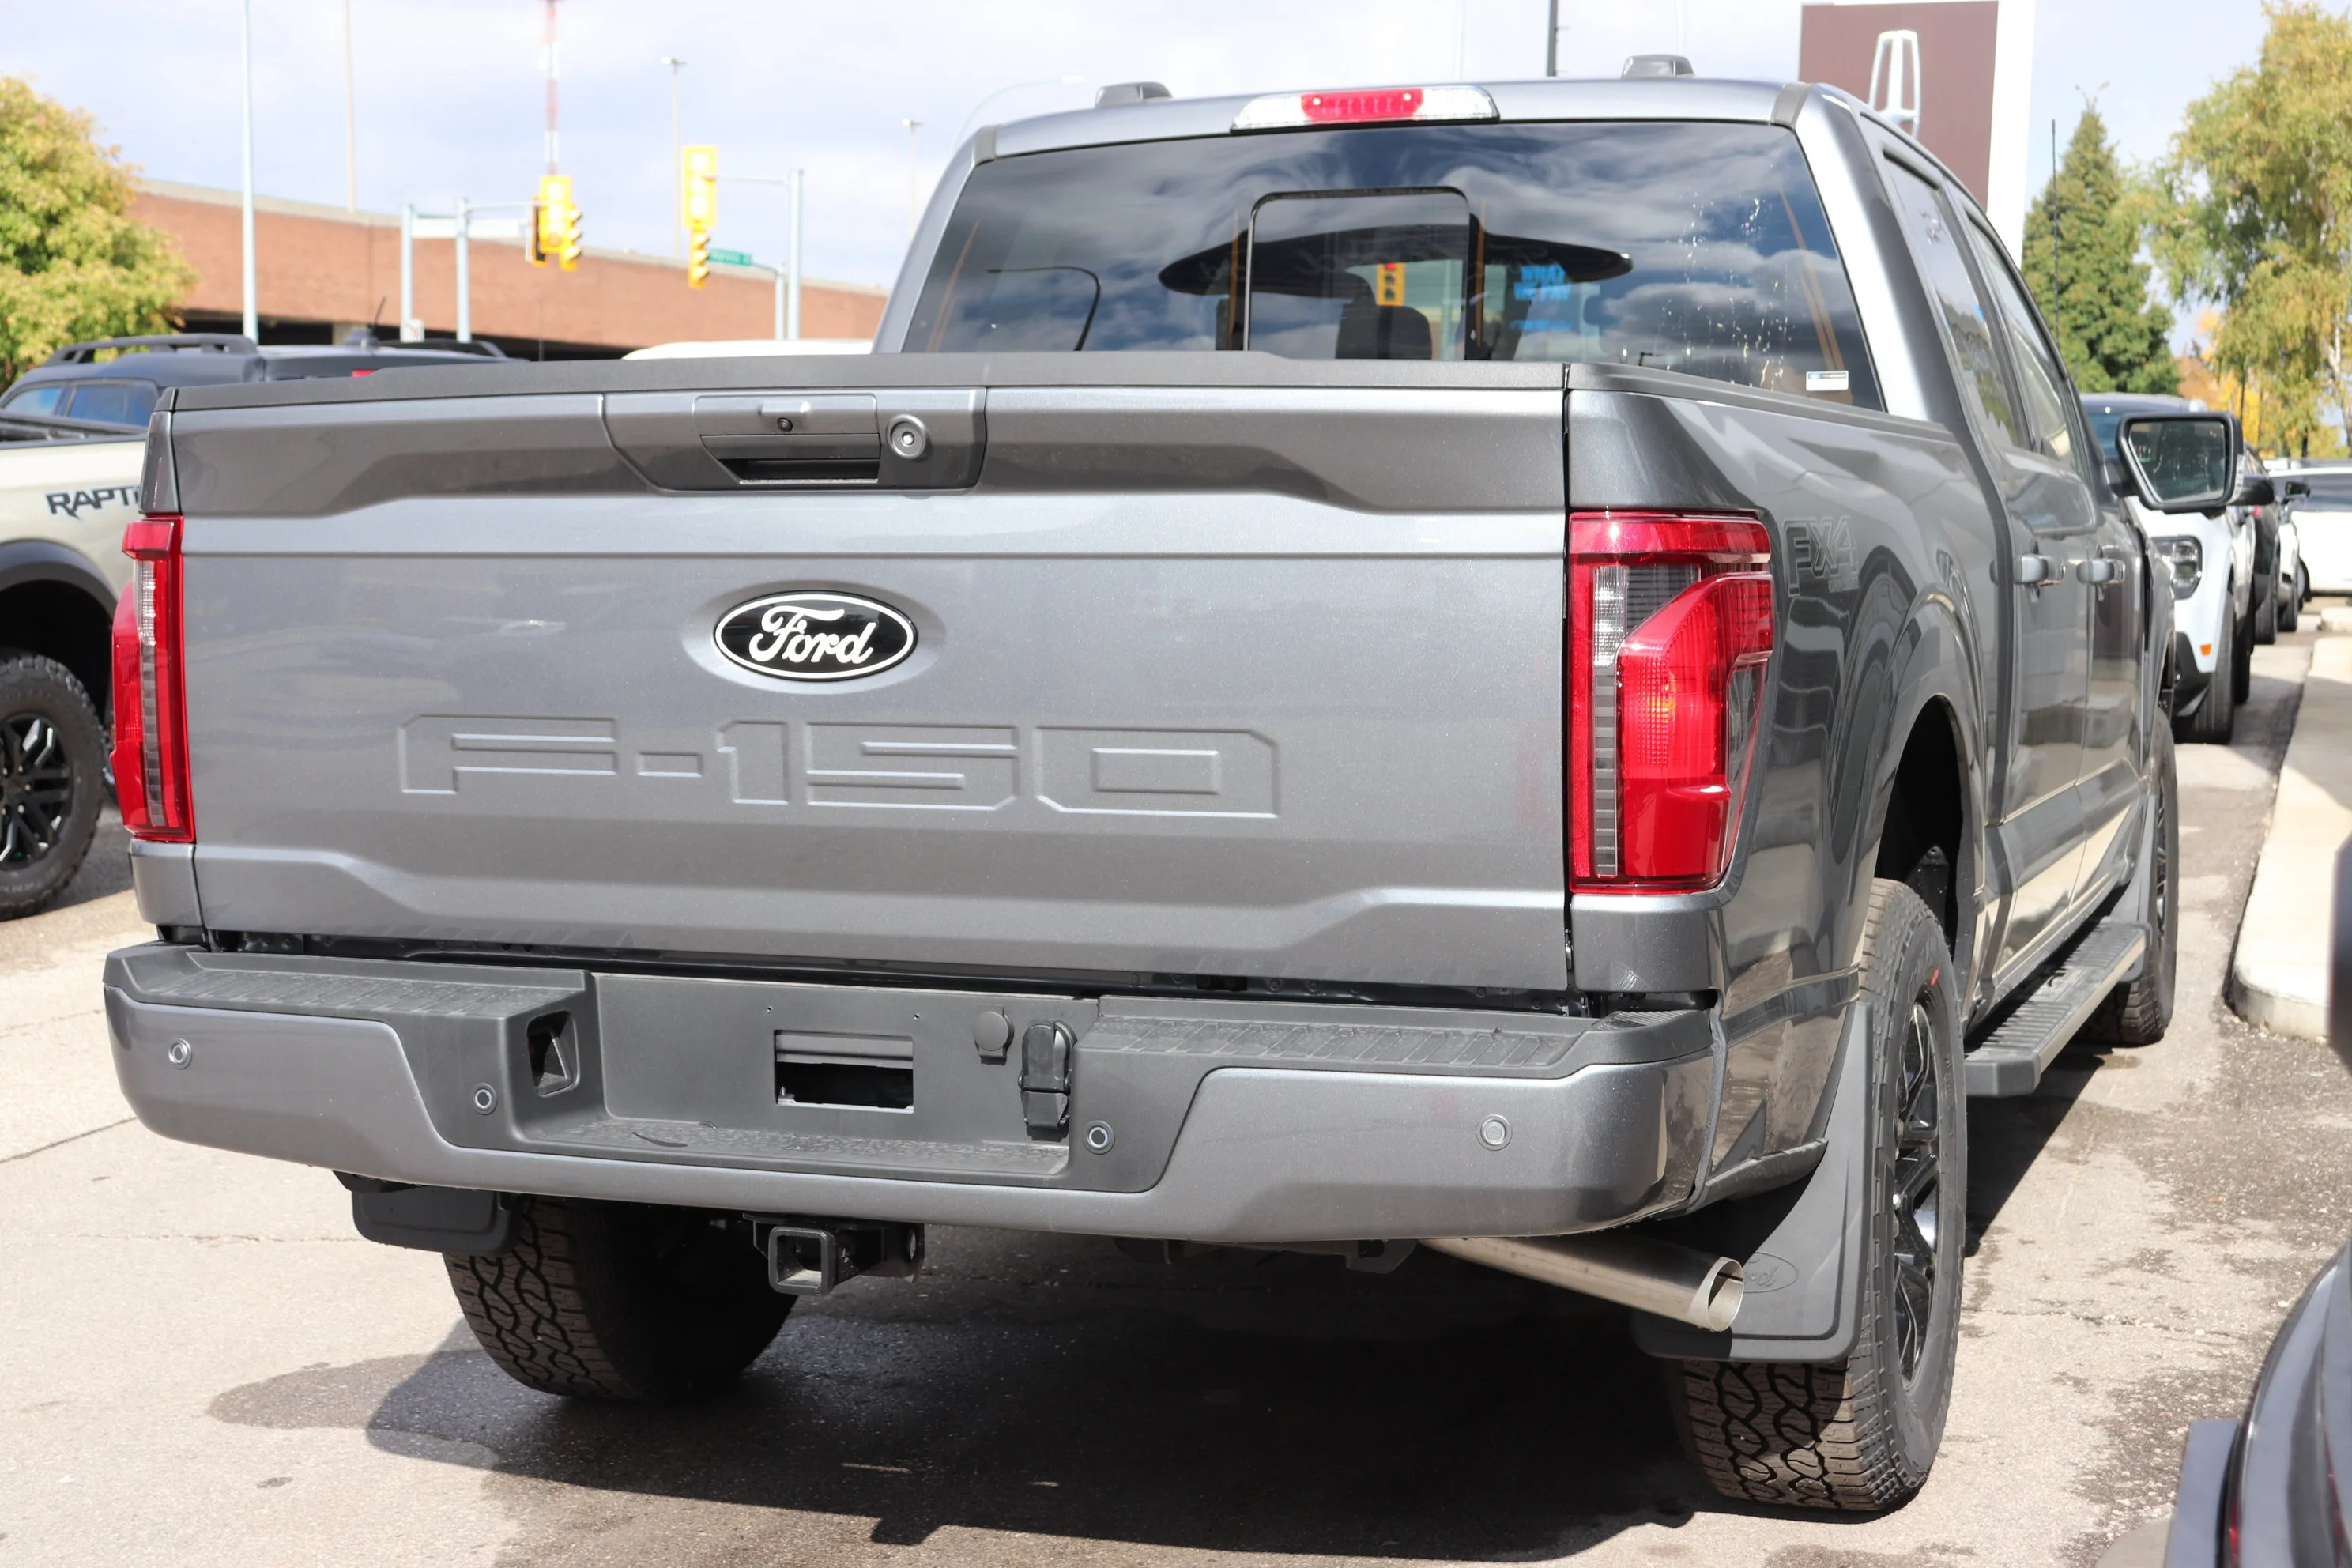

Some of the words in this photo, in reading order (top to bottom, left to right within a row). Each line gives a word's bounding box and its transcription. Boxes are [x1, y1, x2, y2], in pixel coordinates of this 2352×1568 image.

[45, 484, 139, 519] RAPT
[1783, 517, 1858, 597] FX4
[749, 605, 874, 664] Ford
[398, 714, 1279, 819] F-150
